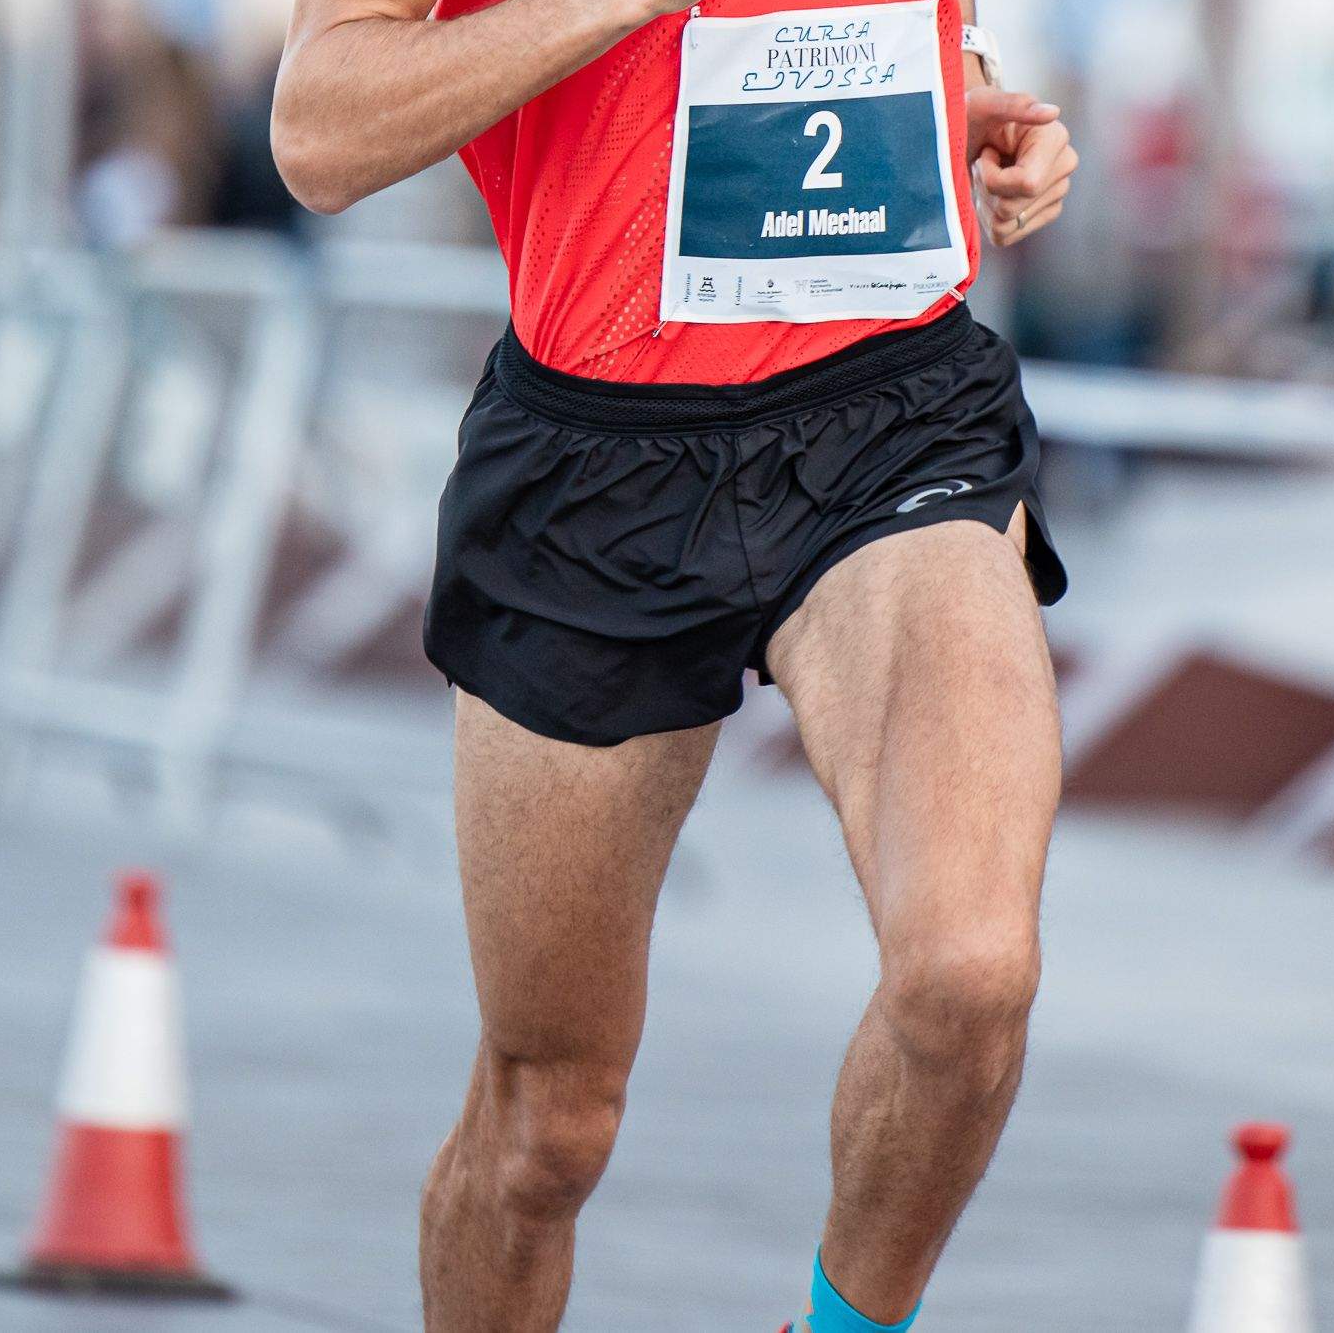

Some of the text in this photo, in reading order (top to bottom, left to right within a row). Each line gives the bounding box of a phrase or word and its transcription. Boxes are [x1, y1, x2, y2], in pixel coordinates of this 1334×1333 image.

[775, 21, 870, 43] CURSA
[766, 42, 876, 69] PATRIMONI
[802, 110, 843, 190] 2
[760, 205, 886, 238] Adel Mechaal
